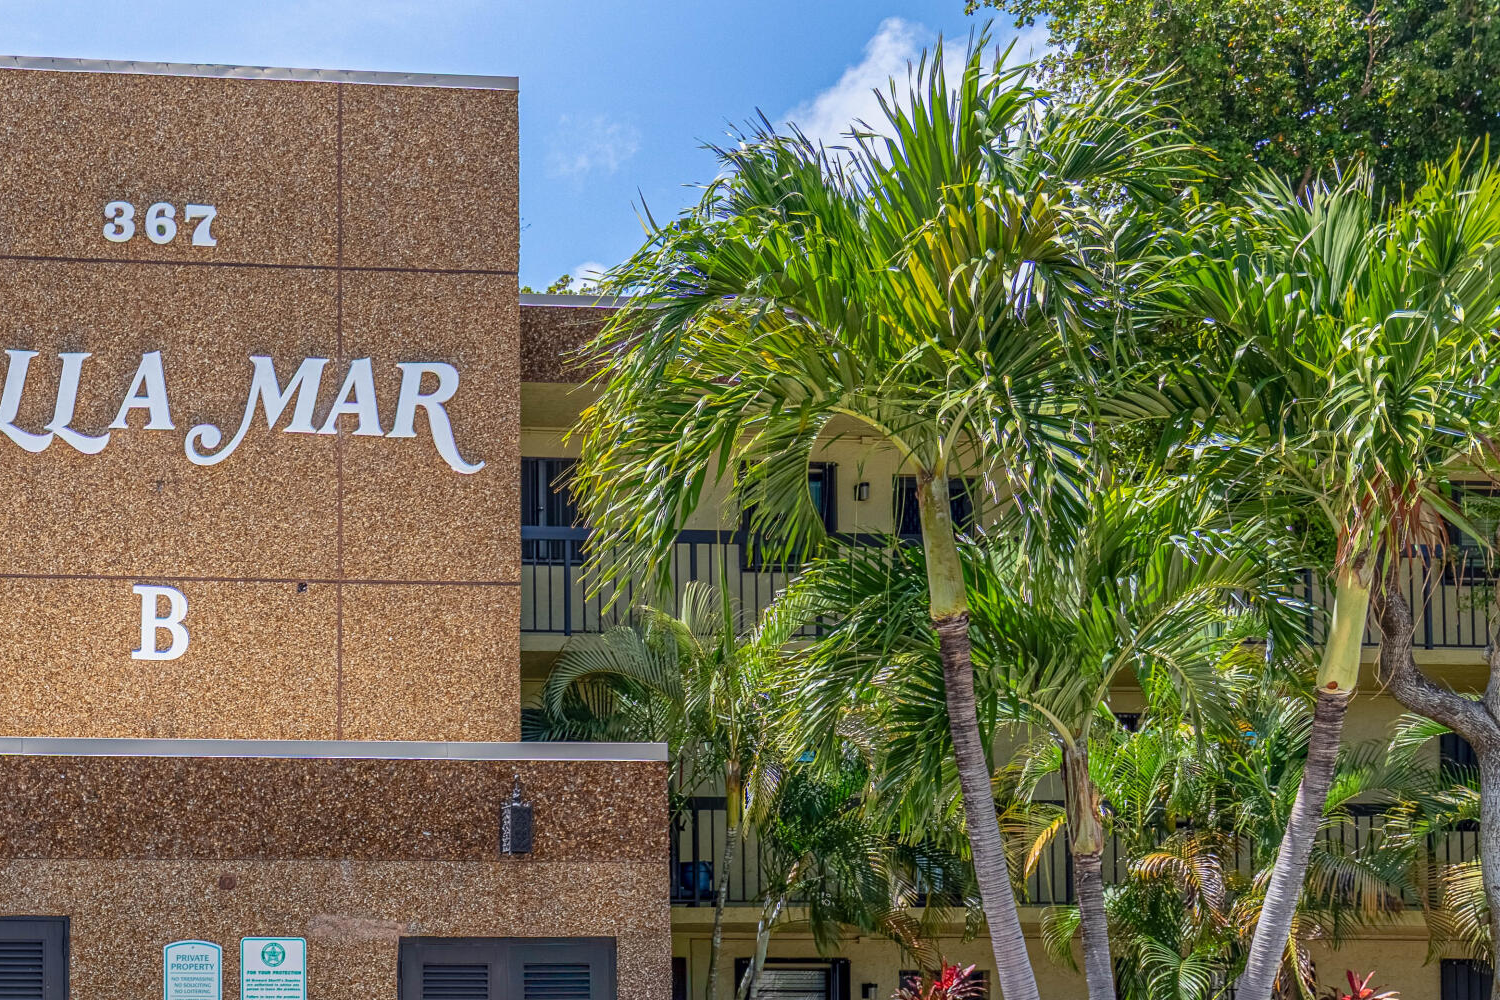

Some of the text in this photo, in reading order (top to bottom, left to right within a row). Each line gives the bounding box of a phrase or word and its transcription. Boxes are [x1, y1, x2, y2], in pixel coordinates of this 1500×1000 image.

[103, 202, 217, 247] 367
[185, 356, 485, 474] MAR
[131, 585, 190, 661] B
[171, 963, 215, 971] PROPERTY
[176, 954, 210, 962] PRIVATE
